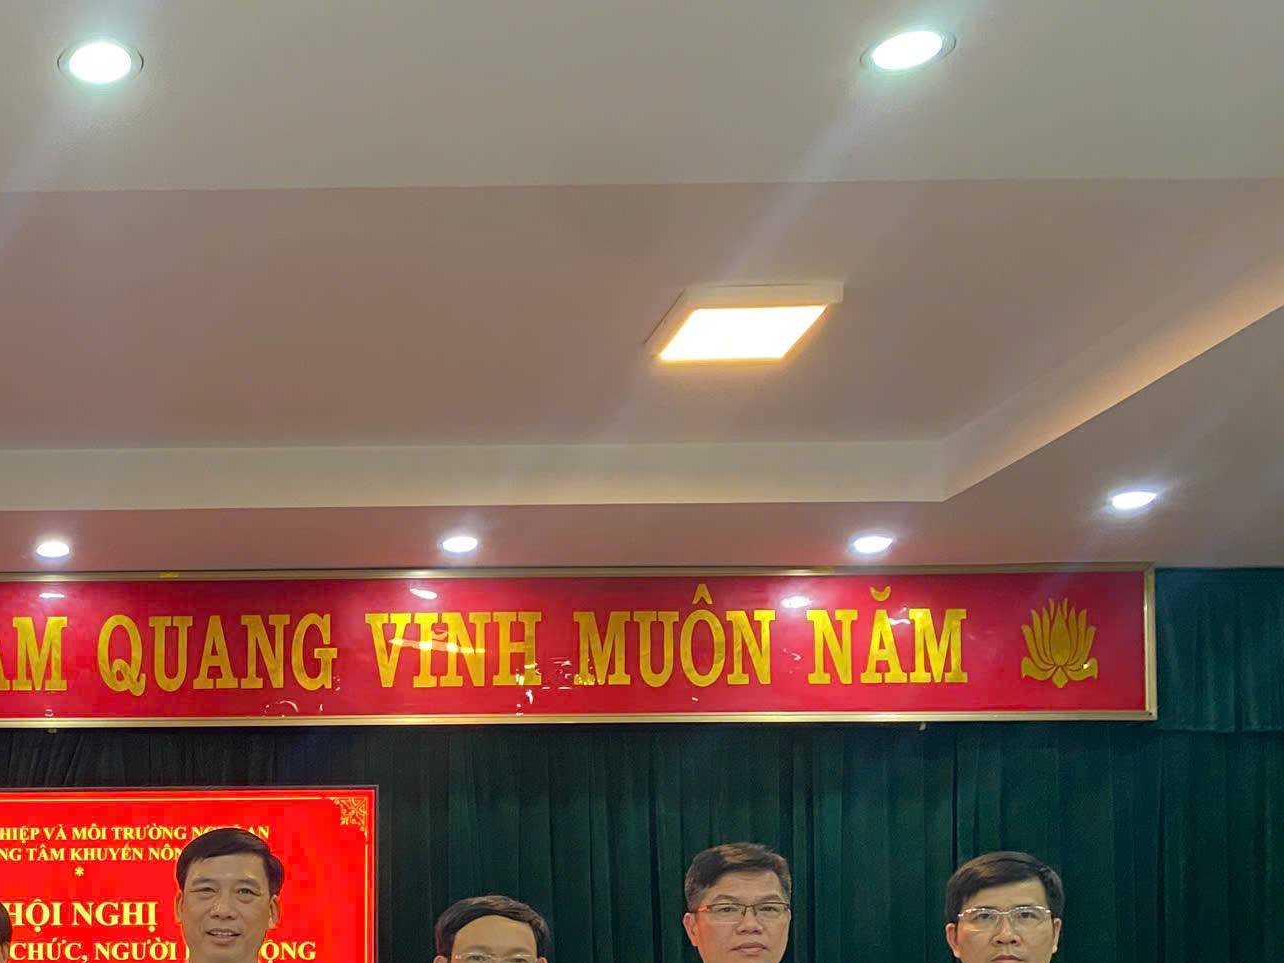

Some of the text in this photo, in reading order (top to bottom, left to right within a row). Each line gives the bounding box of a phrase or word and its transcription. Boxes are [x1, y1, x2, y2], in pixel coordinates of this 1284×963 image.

[97, 613, 337, 697] QUANG
[365, 611, 542, 688] VINH
[574, 584, 776, 687] MUÔN
[807, 586, 968, 685] NĂM
[42, 823, 67, 841] VÀ
[71, 823, 107, 841] MÔI
[111, 823, 187, 841] TRƯỜNG
[25, 843, 65, 862] TÂM
[69, 842, 143, 861] KHUYẾN
[148, 843, 183, 861] NÔN
[2, 898, 158, 933] HỘI NGHỊ
[9, 937, 88, 963] CHỨC,
[94, 937, 178, 961] NGƯỜI
